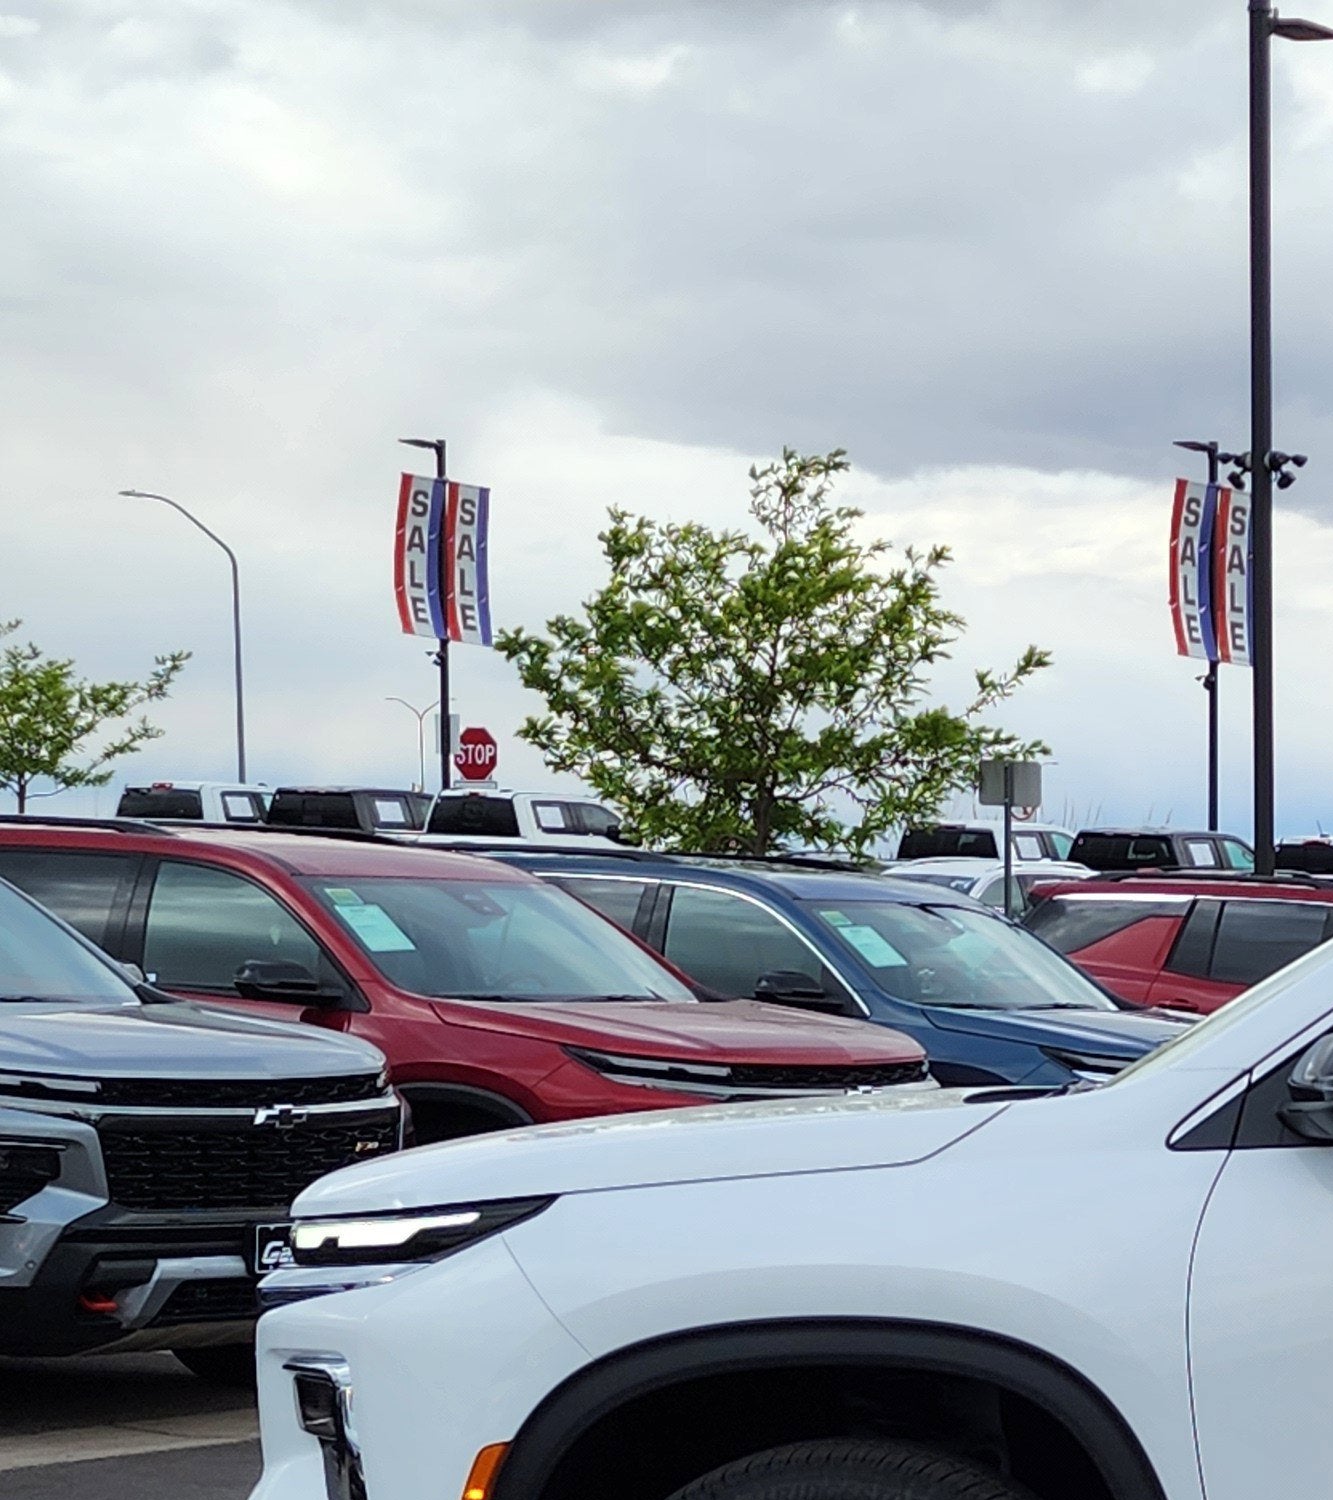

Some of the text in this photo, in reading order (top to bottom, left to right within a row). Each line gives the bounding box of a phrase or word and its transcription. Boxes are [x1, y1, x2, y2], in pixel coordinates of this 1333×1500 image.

[406, 489, 429, 624] SALE
[457, 498, 478, 631] SALE
[1180, 497, 1202, 644] SALE
[1227, 505, 1247, 652] SALE
[456, 743, 496, 766] STOP
